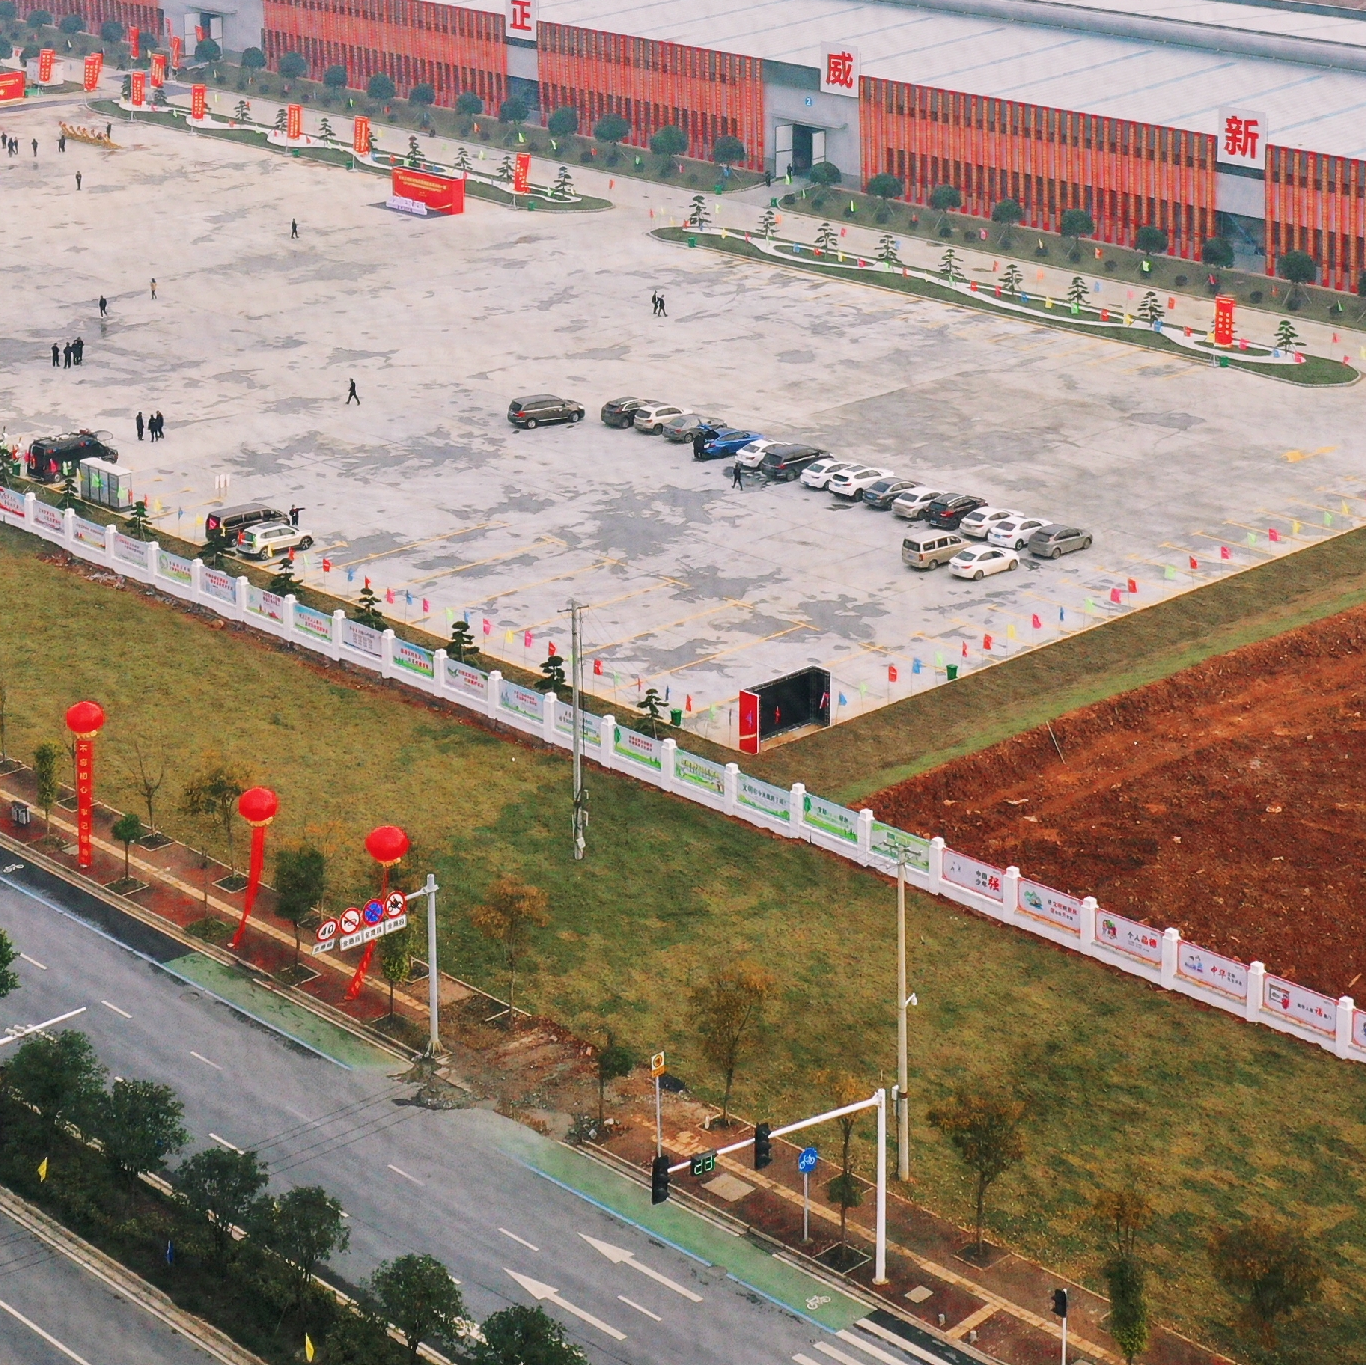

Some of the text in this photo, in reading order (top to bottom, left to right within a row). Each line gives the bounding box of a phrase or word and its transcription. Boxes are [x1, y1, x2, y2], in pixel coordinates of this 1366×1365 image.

[510, 0, 532, 31] 正
[826, 51, 853, 88] 威
[806, 98, 811, 106] 2
[1224, 115, 1259, 159] 新
[320, 924, 334, 936] 40
